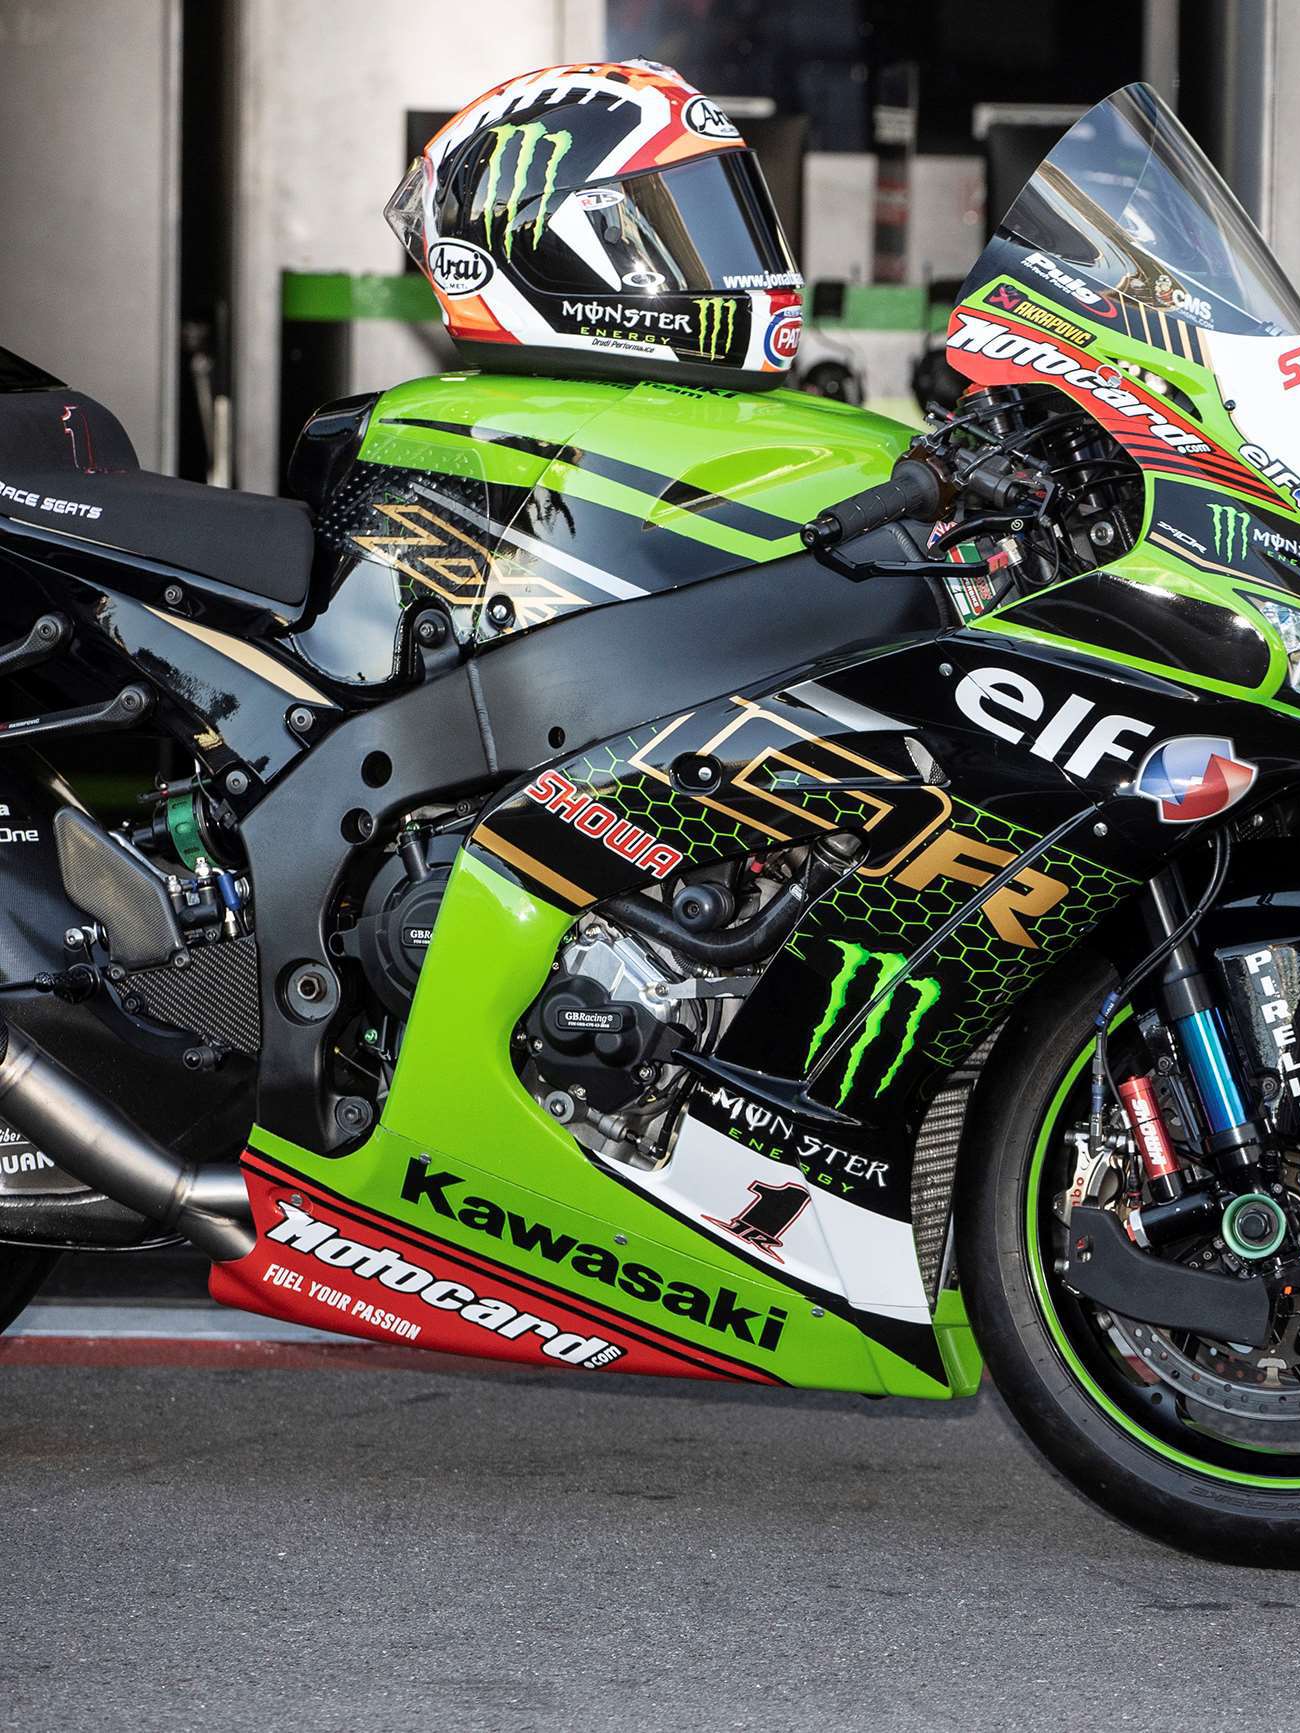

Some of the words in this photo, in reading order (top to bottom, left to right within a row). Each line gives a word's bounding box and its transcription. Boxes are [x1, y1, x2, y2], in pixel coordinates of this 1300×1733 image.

[433, 248, 482, 280] Arai
[562, 300, 693, 333] MONSTER
[580, 327, 671, 345] ENERGY
[1172, 289, 1212, 320] CMS
[40, 497, 103, 519] SEATS
[955, 667, 1156, 779] elf
[524, 769, 683, 879] SHOWA
[711, 1087, 889, 1187] MONSTER
[728, 1127, 855, 1193] ENERGY
[1131, 1098, 1168, 1166] SHOWA
[400, 1157, 790, 1353] Kawasaki
[262, 1264, 302, 1293] FUEL
[308, 1280, 352, 1312] YOUR
[351, 1299, 421, 1340] PASSION
